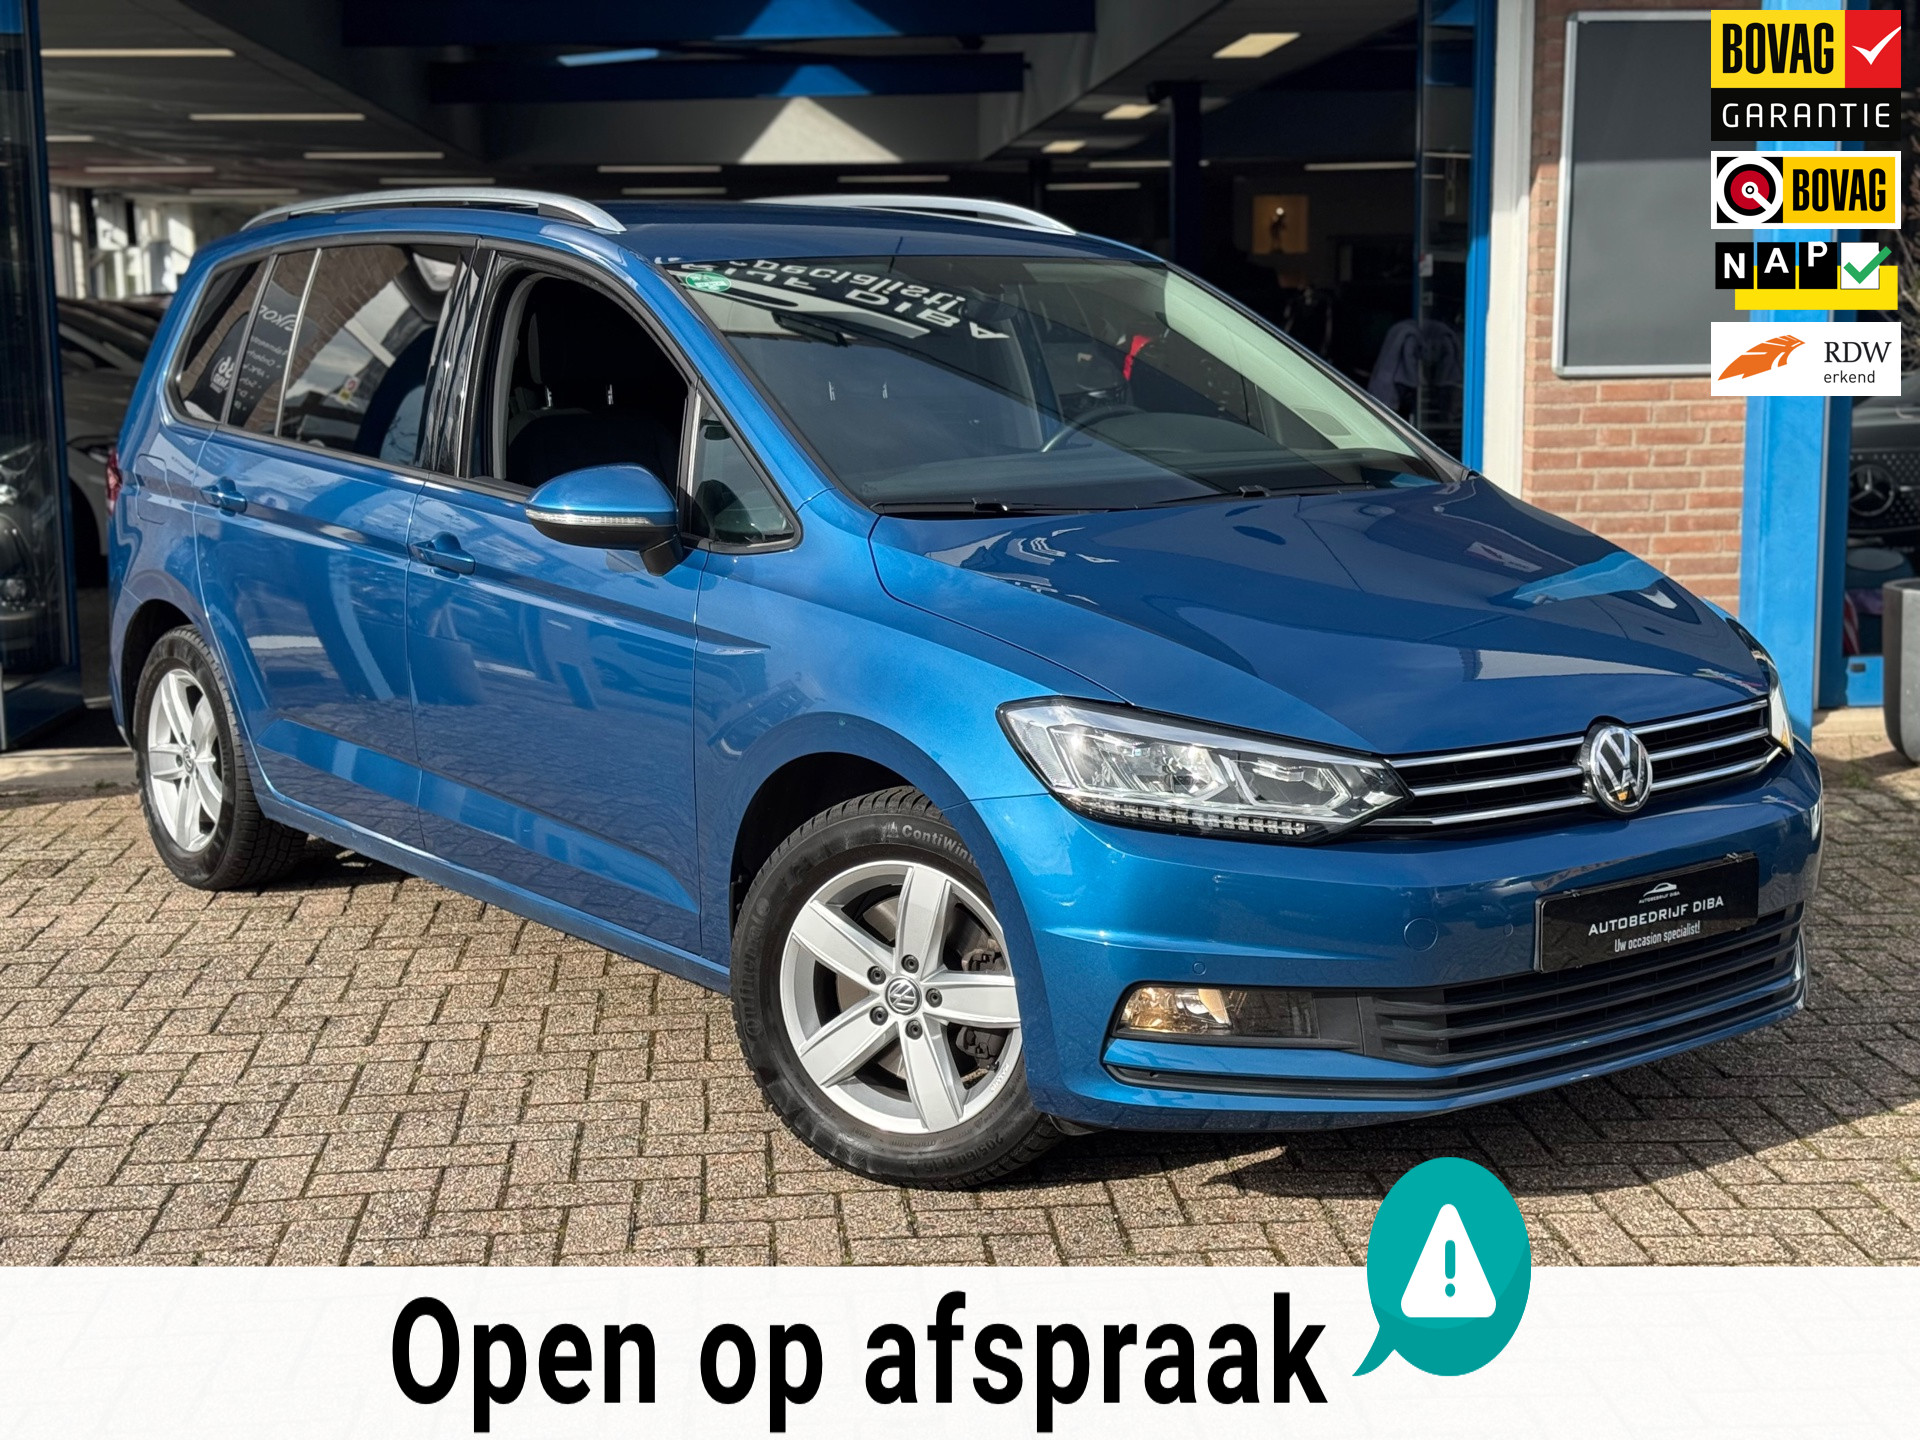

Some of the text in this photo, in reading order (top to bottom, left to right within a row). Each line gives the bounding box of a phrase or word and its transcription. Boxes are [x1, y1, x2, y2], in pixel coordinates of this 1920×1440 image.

[1588, 895, 1724, 936] AUTOBEDRIJF DIBA
[1614, 920, 1701, 953] Uw occasion specialist!
